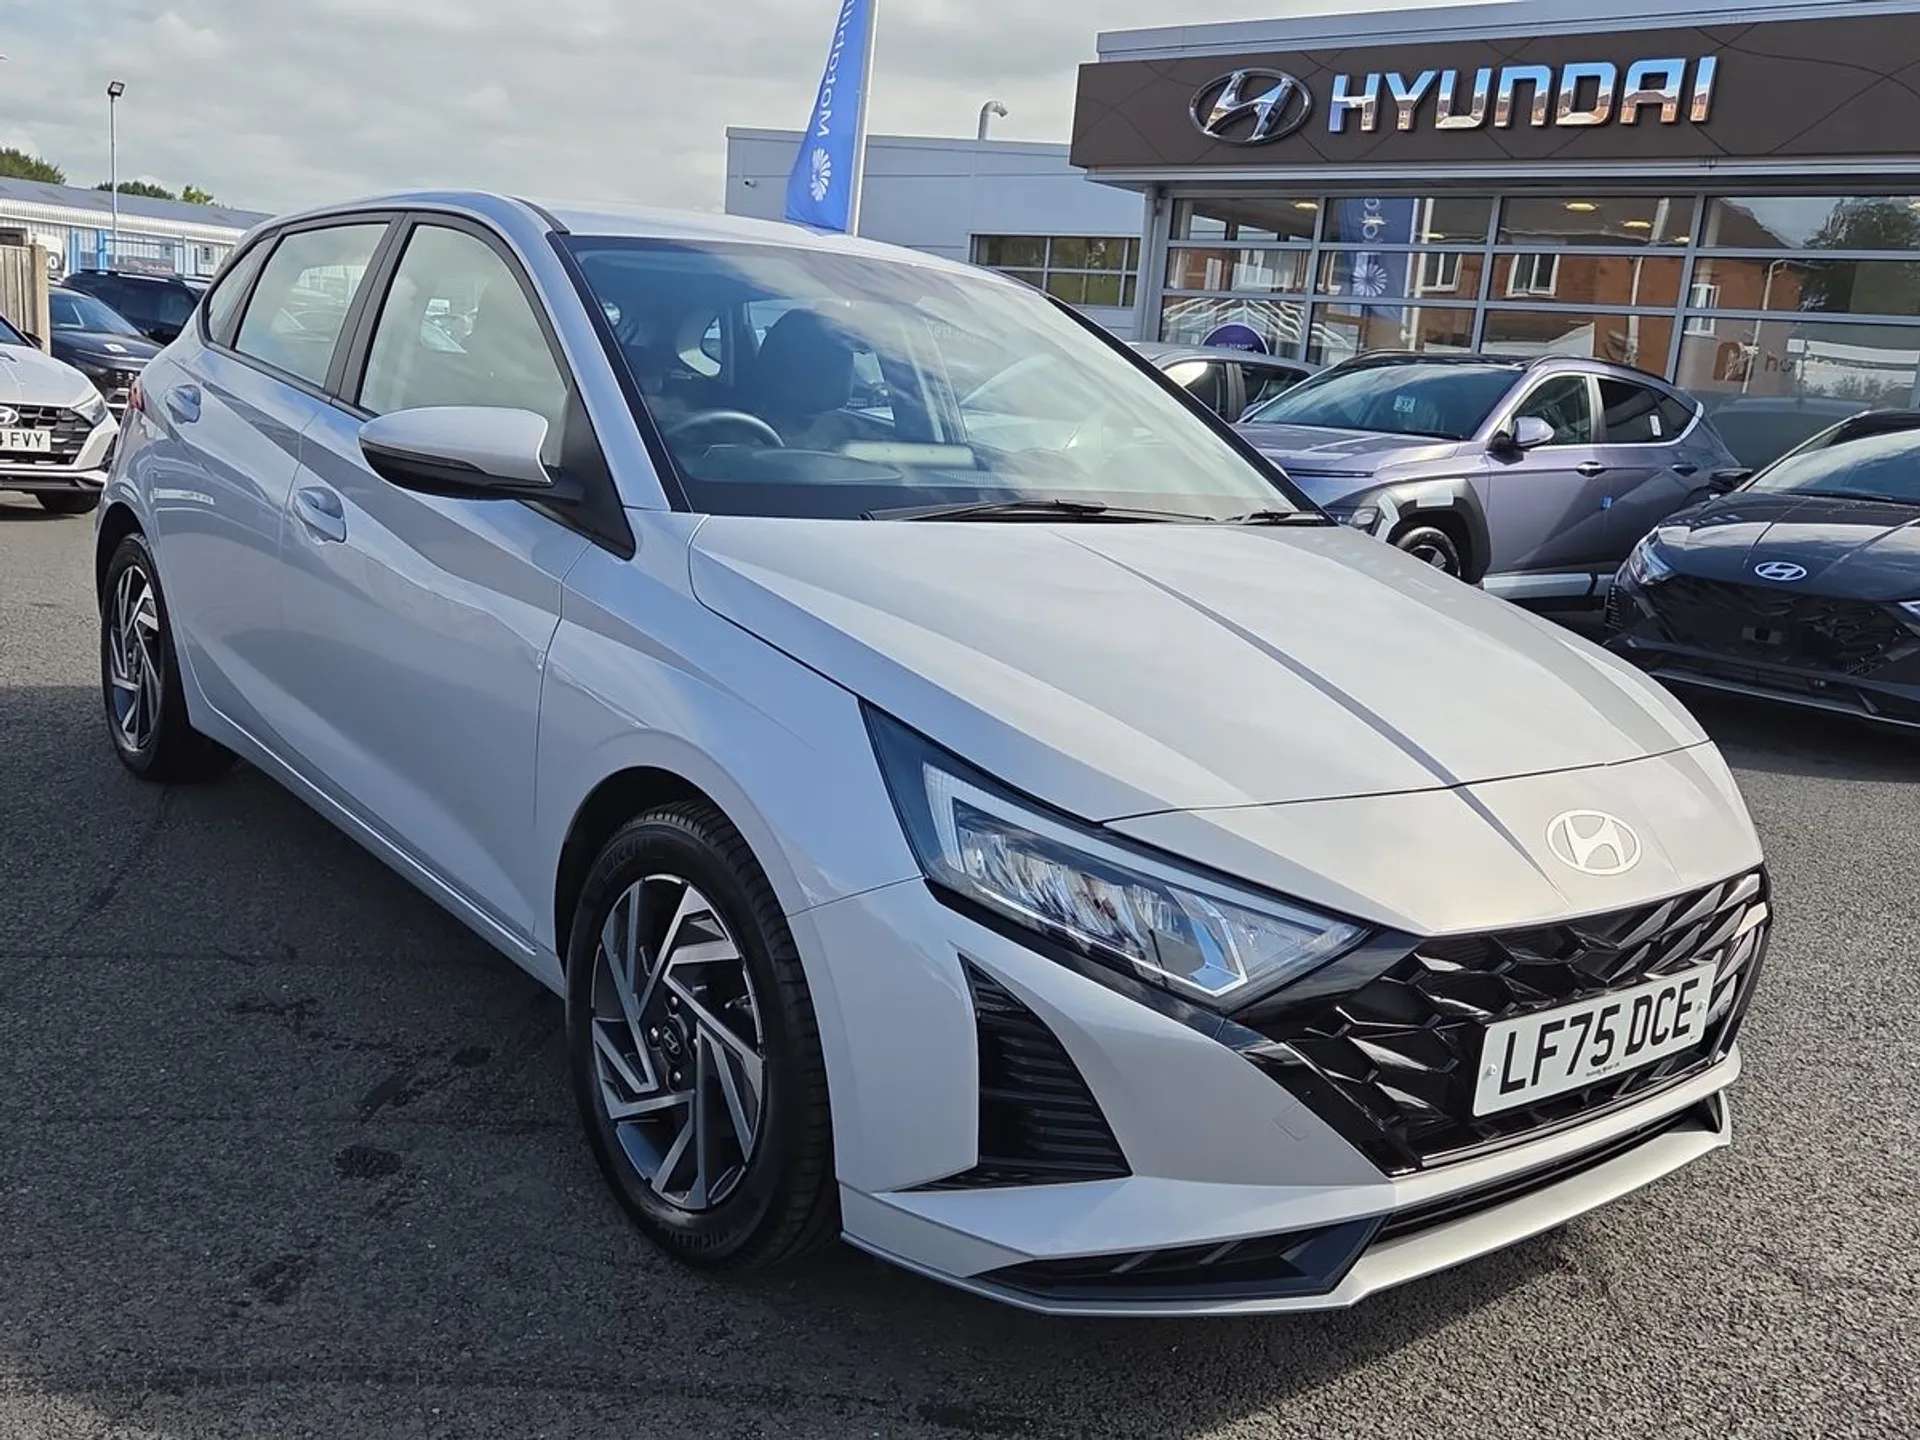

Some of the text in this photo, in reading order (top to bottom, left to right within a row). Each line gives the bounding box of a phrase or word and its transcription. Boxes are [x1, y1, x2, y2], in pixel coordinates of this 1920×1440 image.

[1327, 55, 1717, 133] HYUNDAI
[10, 431, 44, 448] FVY
[1499, 977, 1700, 1096] LF75 DCE
